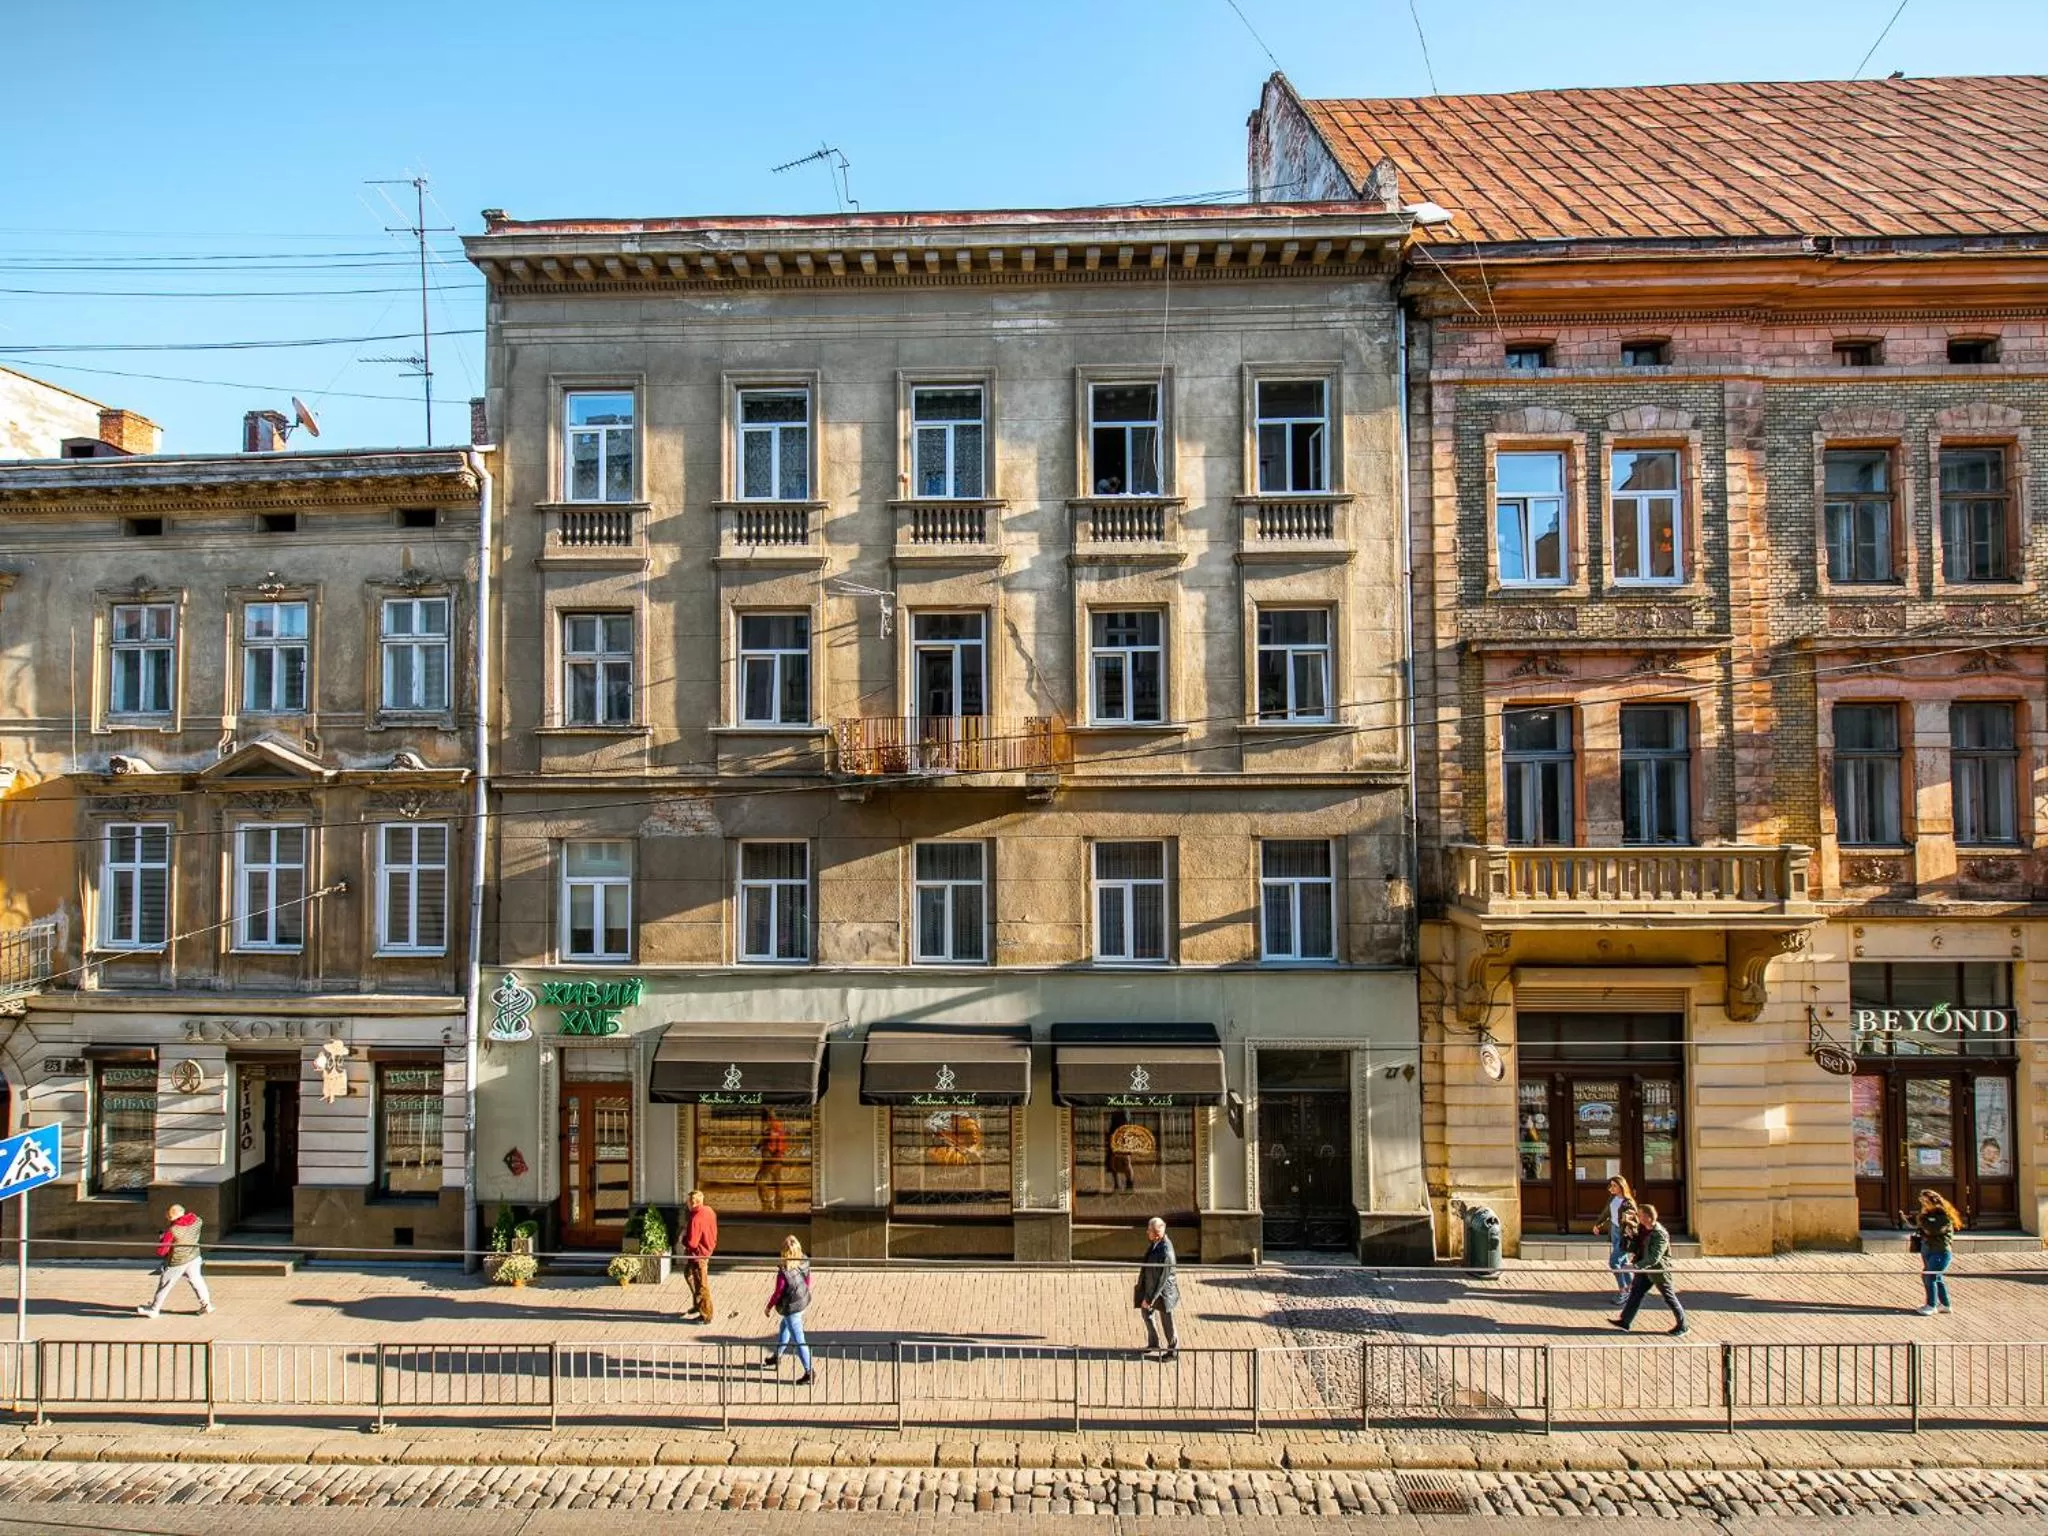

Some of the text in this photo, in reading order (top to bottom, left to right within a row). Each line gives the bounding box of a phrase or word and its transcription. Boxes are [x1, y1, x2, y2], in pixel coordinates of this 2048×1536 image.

[537, 977, 644, 1008] ЖИВИЙ
[180, 1019, 344, 1042] ЯХОНТ
[558, 1009, 625, 1036] ХЛІБ
[1857, 1008, 2008, 1033] BEYOND
[1384, 1067, 1400, 1079] 27
